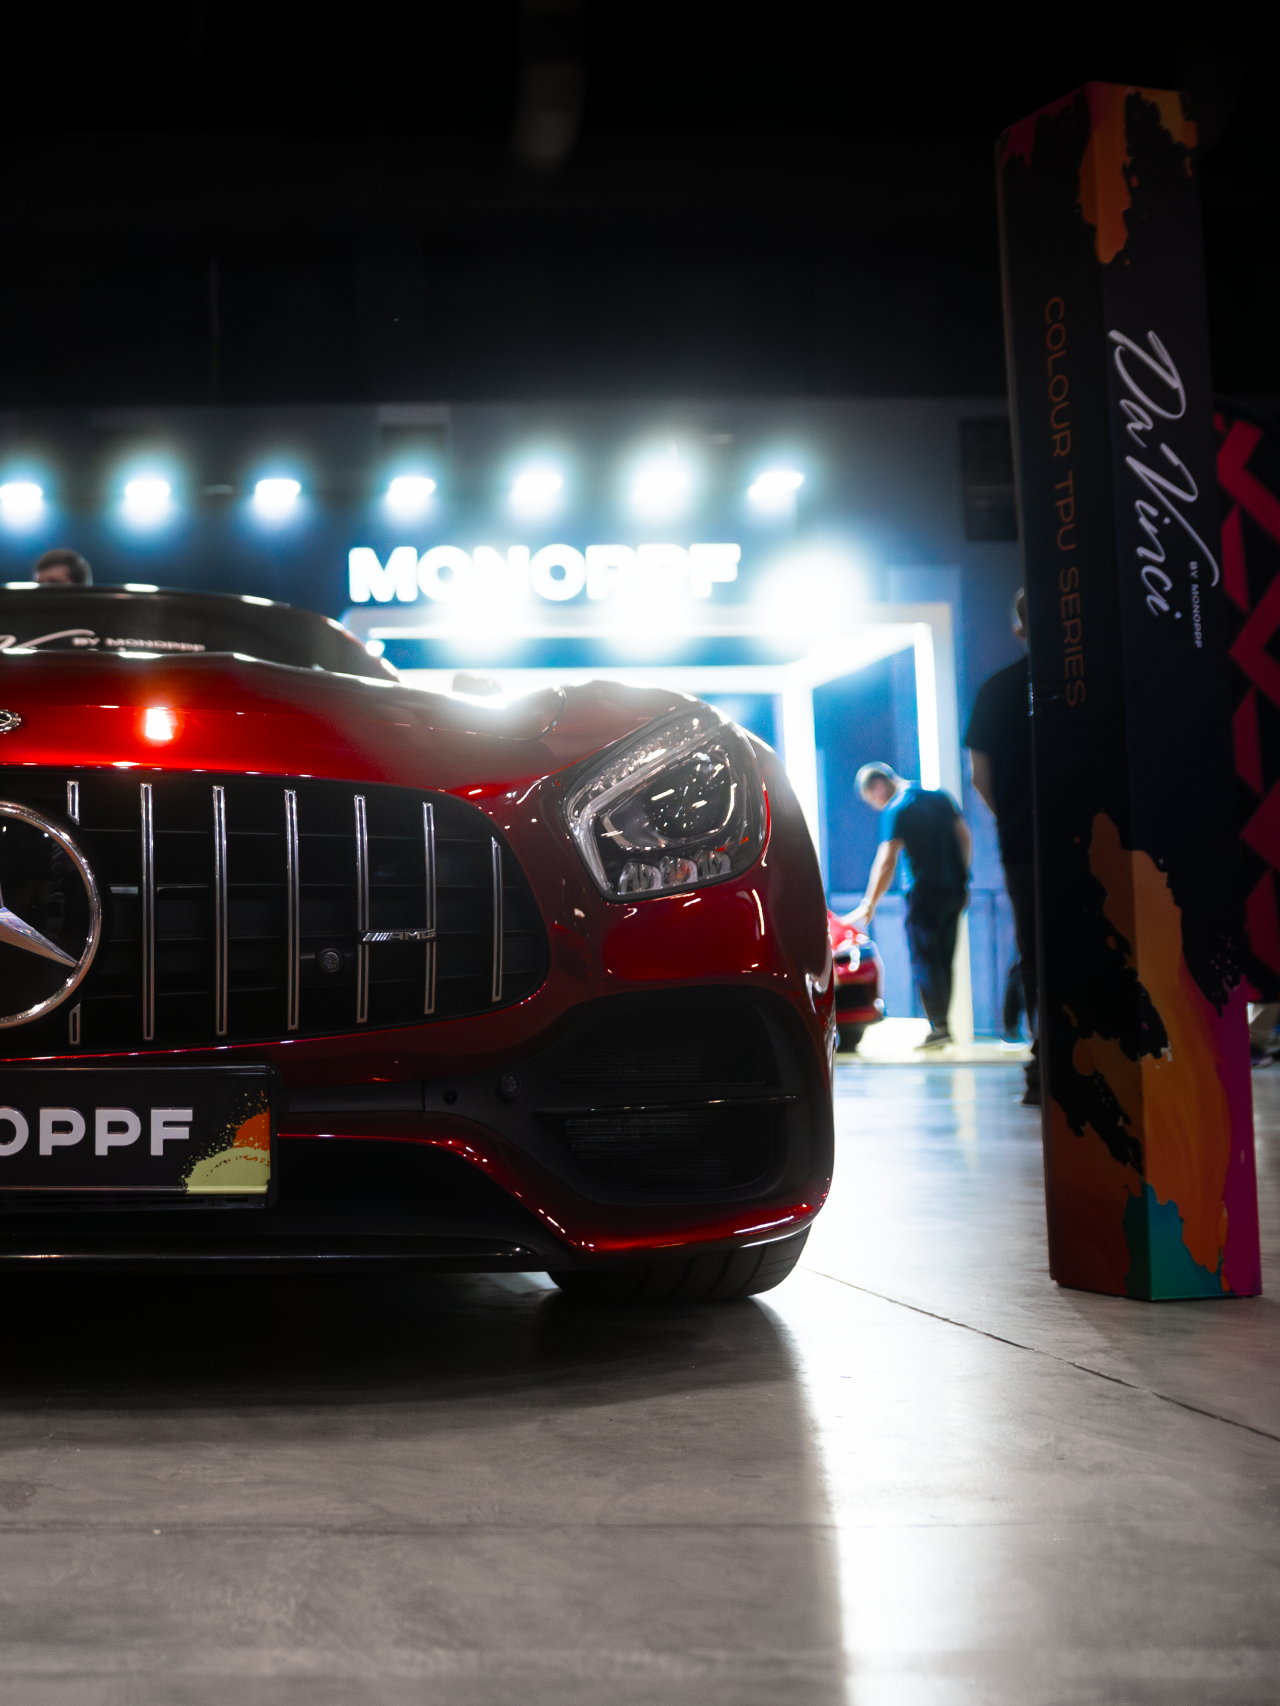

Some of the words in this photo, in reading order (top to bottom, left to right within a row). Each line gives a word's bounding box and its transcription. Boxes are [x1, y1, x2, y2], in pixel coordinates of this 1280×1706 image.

[1044, 296, 1071, 458] COLOUR
[1054, 469, 1077, 552] TPU
[348, 543, 742, 602] MONOPPF
[1189, 560, 1198, 579] BY
[1057, 565, 1086, 707] SERIES
[1191, 584, 1203, 649] MONOPPF
